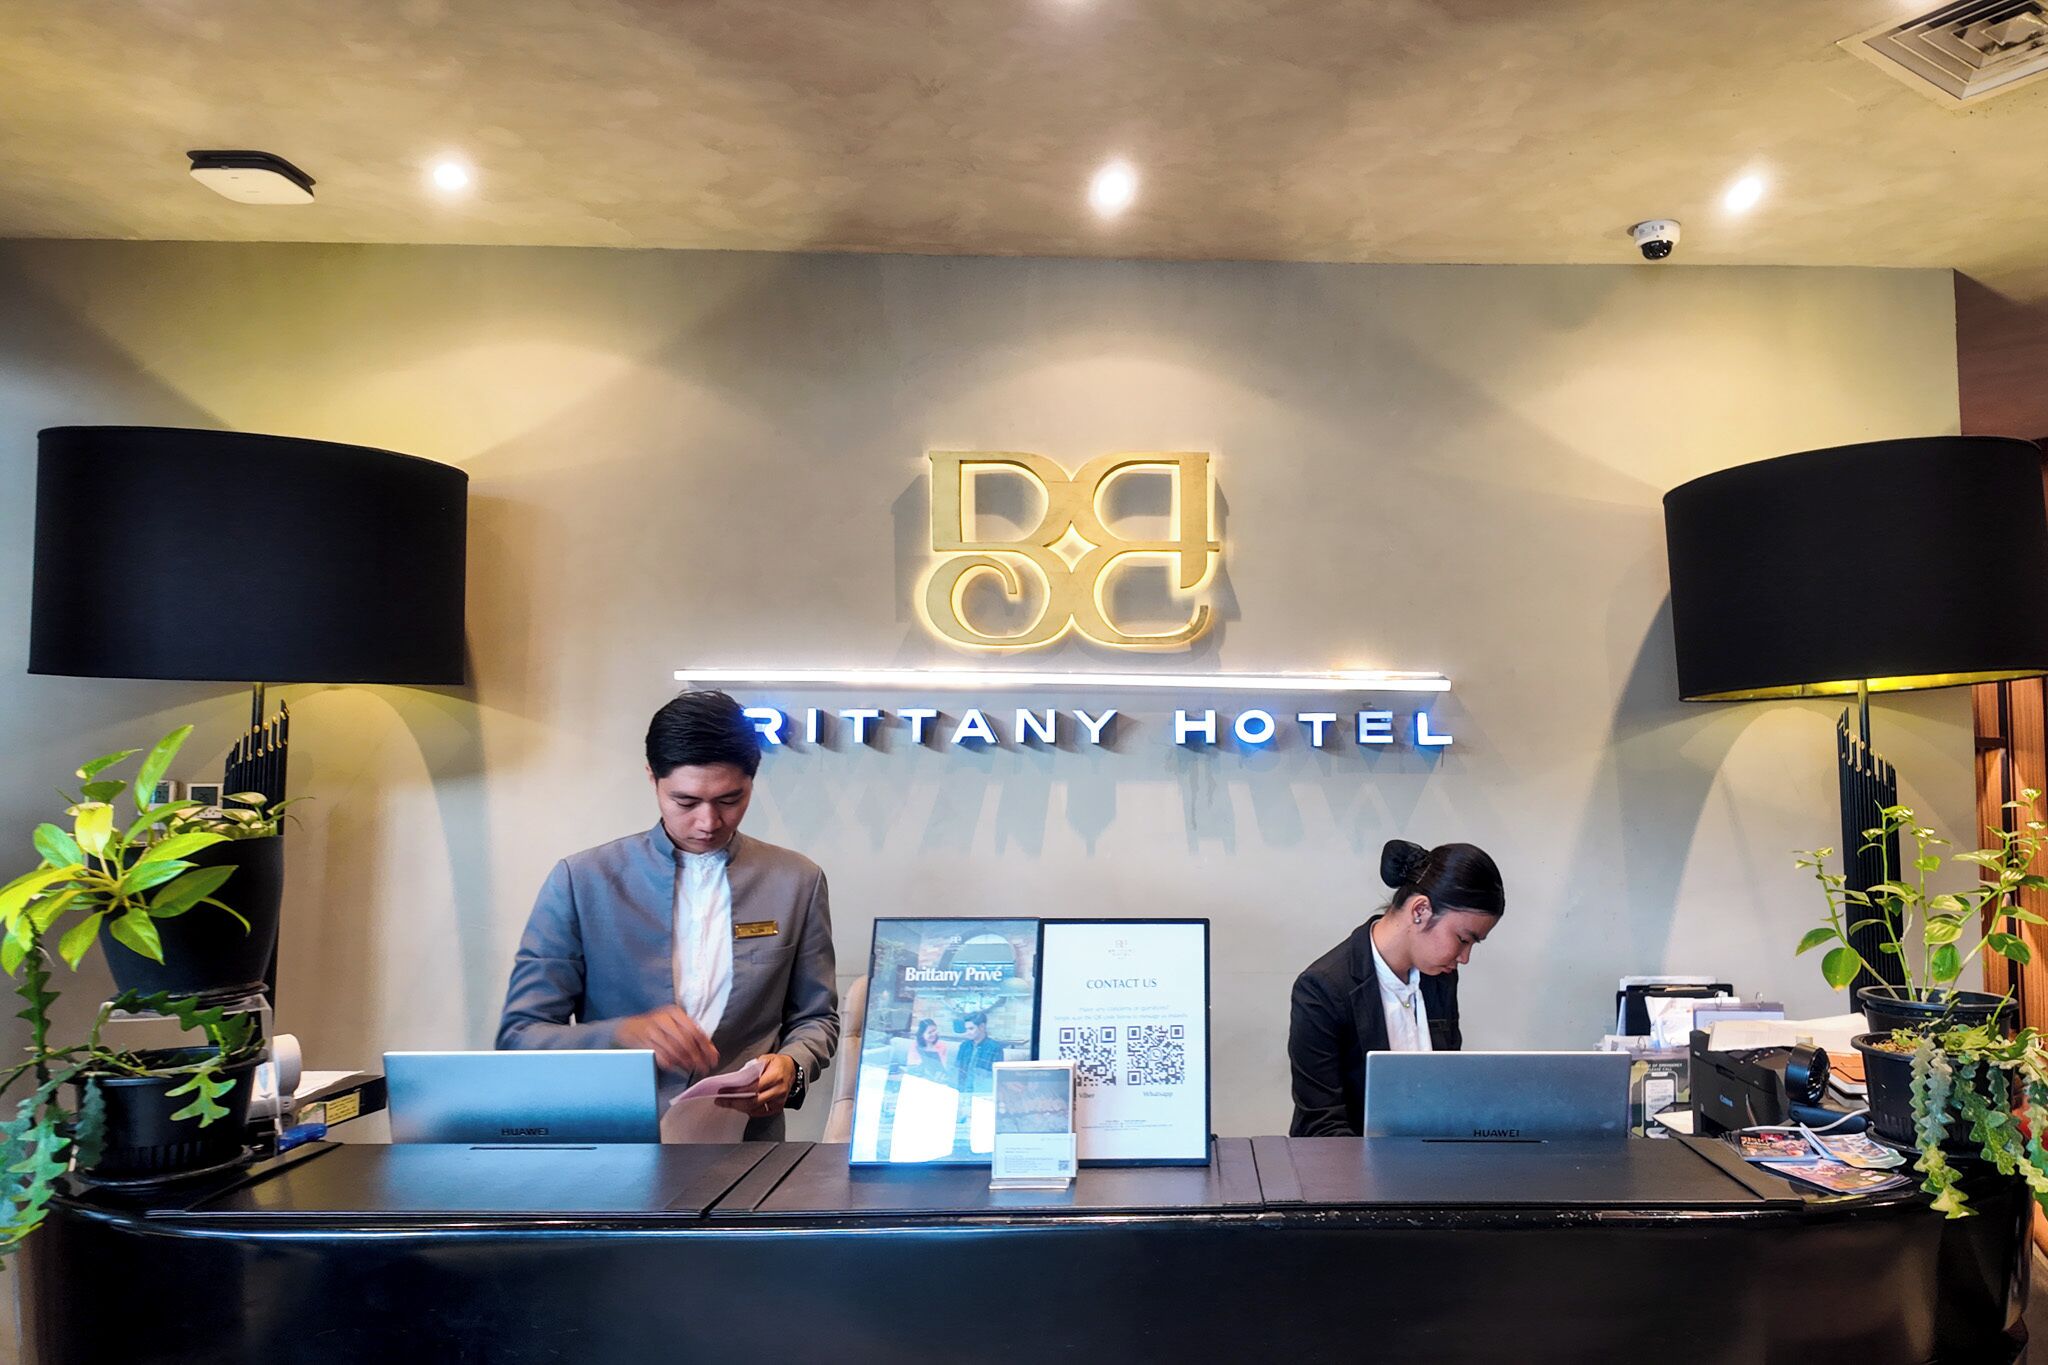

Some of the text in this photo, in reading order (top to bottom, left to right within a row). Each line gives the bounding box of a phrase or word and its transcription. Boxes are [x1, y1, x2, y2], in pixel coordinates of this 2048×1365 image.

[744, 707, 1454, 748] RITTANY HOTEL
[904, 965, 1003, 986] Brittany Privé
[1086, 977, 1158, 989] CONTACT US
[501, 1127, 549, 1136] HUAWEI
[1473, 1128, 1520, 1138] HUAWEI
